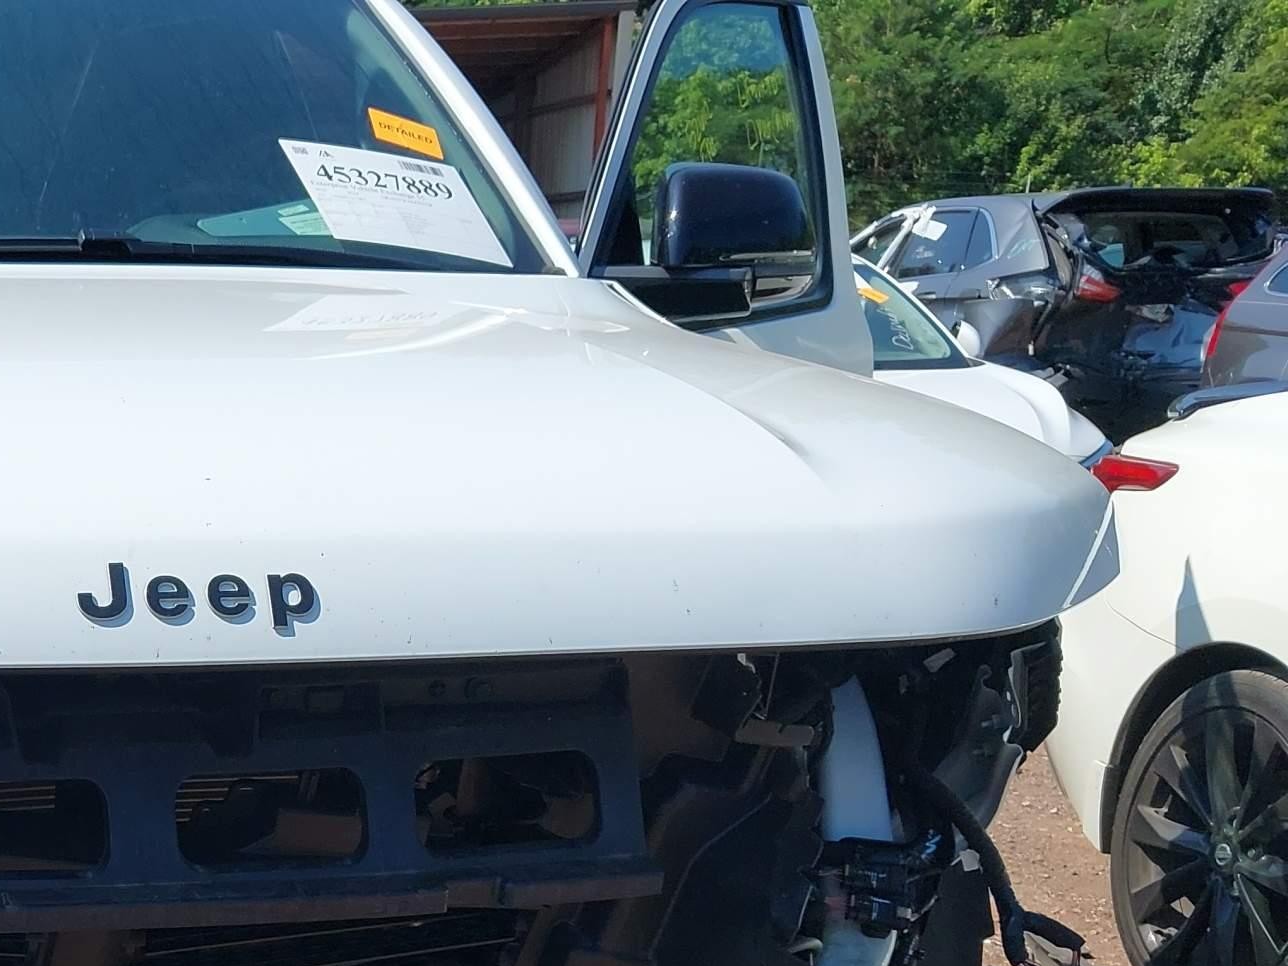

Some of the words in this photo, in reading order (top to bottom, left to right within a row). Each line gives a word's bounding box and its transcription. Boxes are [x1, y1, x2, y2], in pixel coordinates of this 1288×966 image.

[378, 121, 433, 144] DETAILED
[316, 164, 453, 199] 45327889
[77, 562, 316, 629] Jeep
